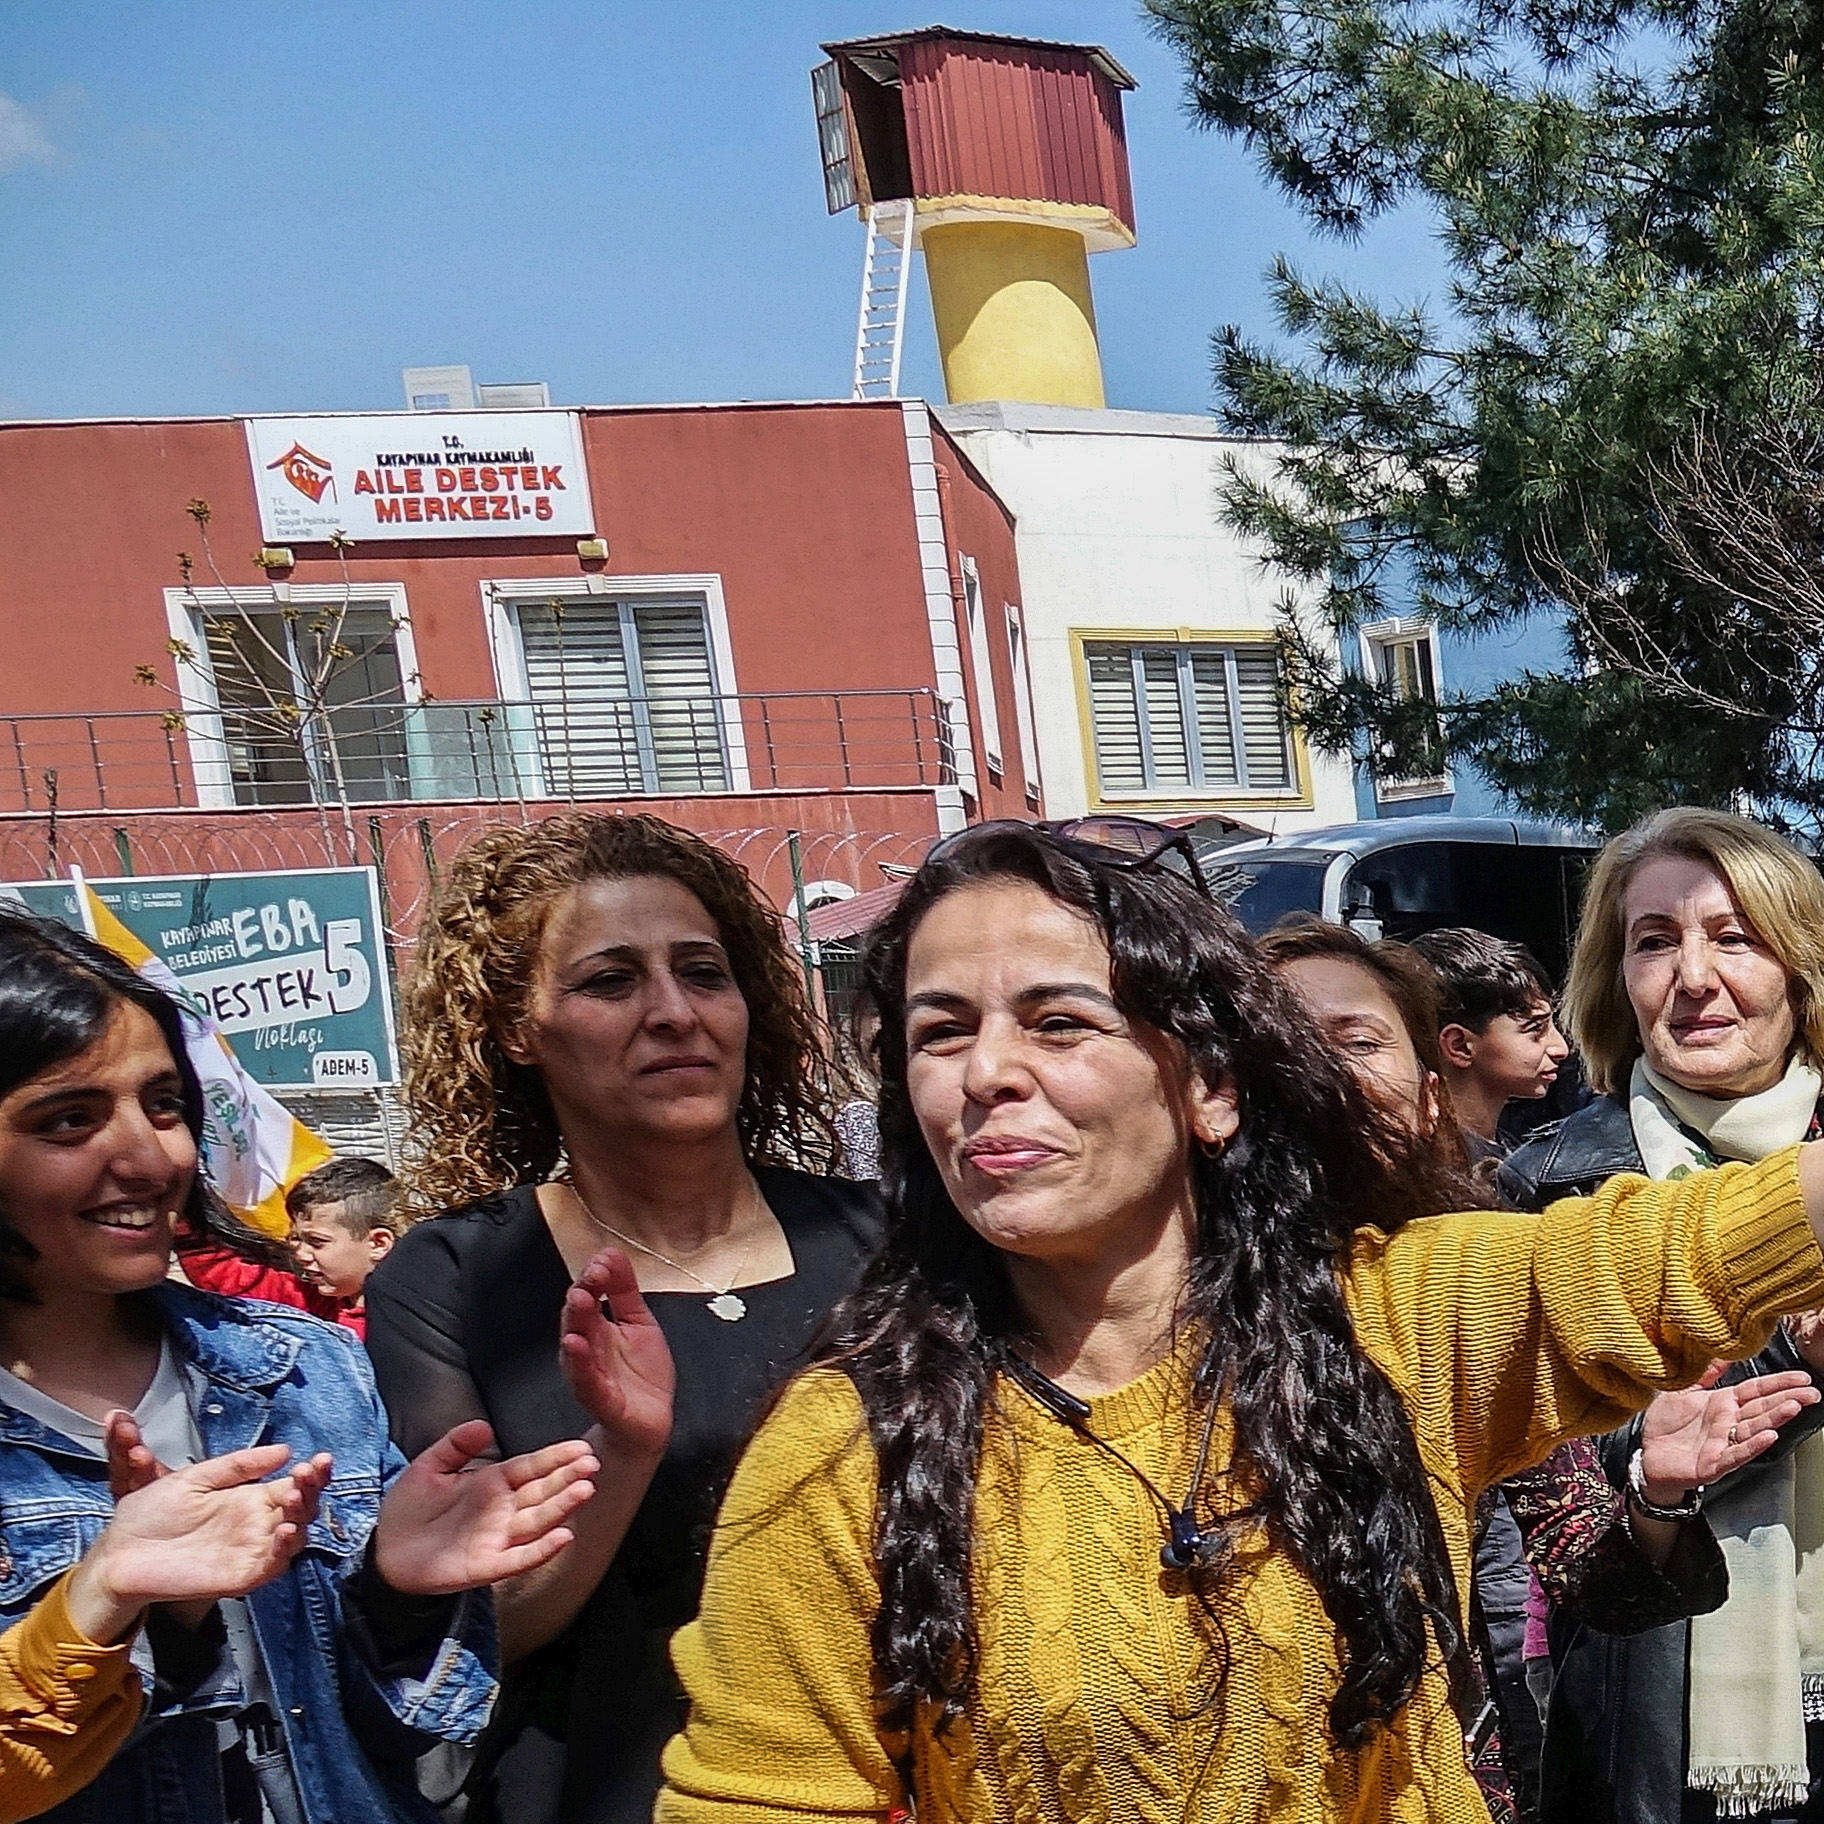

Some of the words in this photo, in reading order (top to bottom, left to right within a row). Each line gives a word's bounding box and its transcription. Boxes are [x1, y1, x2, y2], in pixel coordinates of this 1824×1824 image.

[354, 467, 424, 495] AİLE
[435, 465, 567, 492] DESTEK
[160, 917, 234, 949] KAYAPINAR
[231, 898, 322, 959] EBA
[167, 940, 238, 971] BELEDİYESİ
[323, 917, 372, 1015] 5
[320, 1058, 370, 1077] ADEM-5
